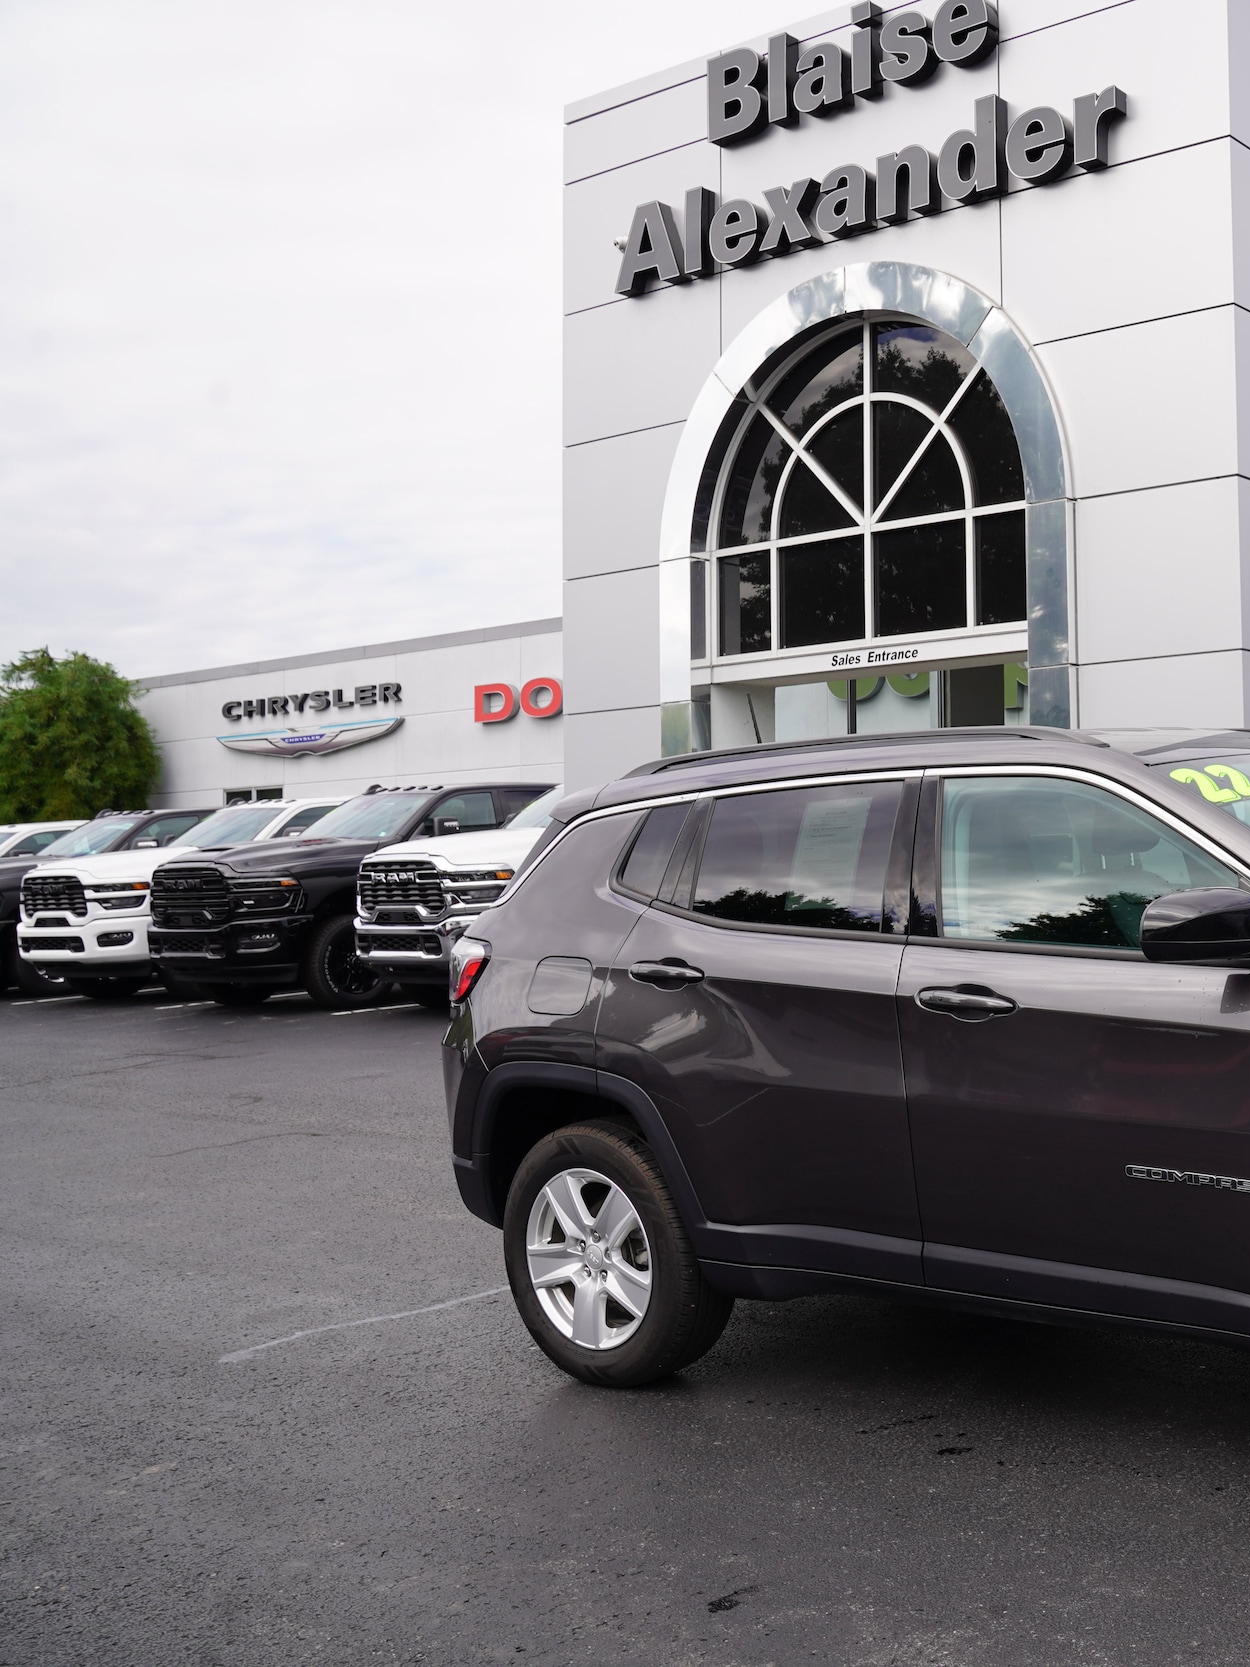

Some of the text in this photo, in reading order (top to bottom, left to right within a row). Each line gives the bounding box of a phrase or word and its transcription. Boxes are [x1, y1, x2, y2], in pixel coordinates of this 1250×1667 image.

[706, 0, 998, 146] Blaise
[614, 85, 1127, 296] Alexander
[831, 648, 919, 667] Sales Entrance
[222, 682, 402, 721] CHRYSLER
[284, 735, 321, 743] CHRYSLER
[163, 879, 201, 889] RAM
[371, 871, 415, 883] RAM
[32, 884, 65, 894] RAM
